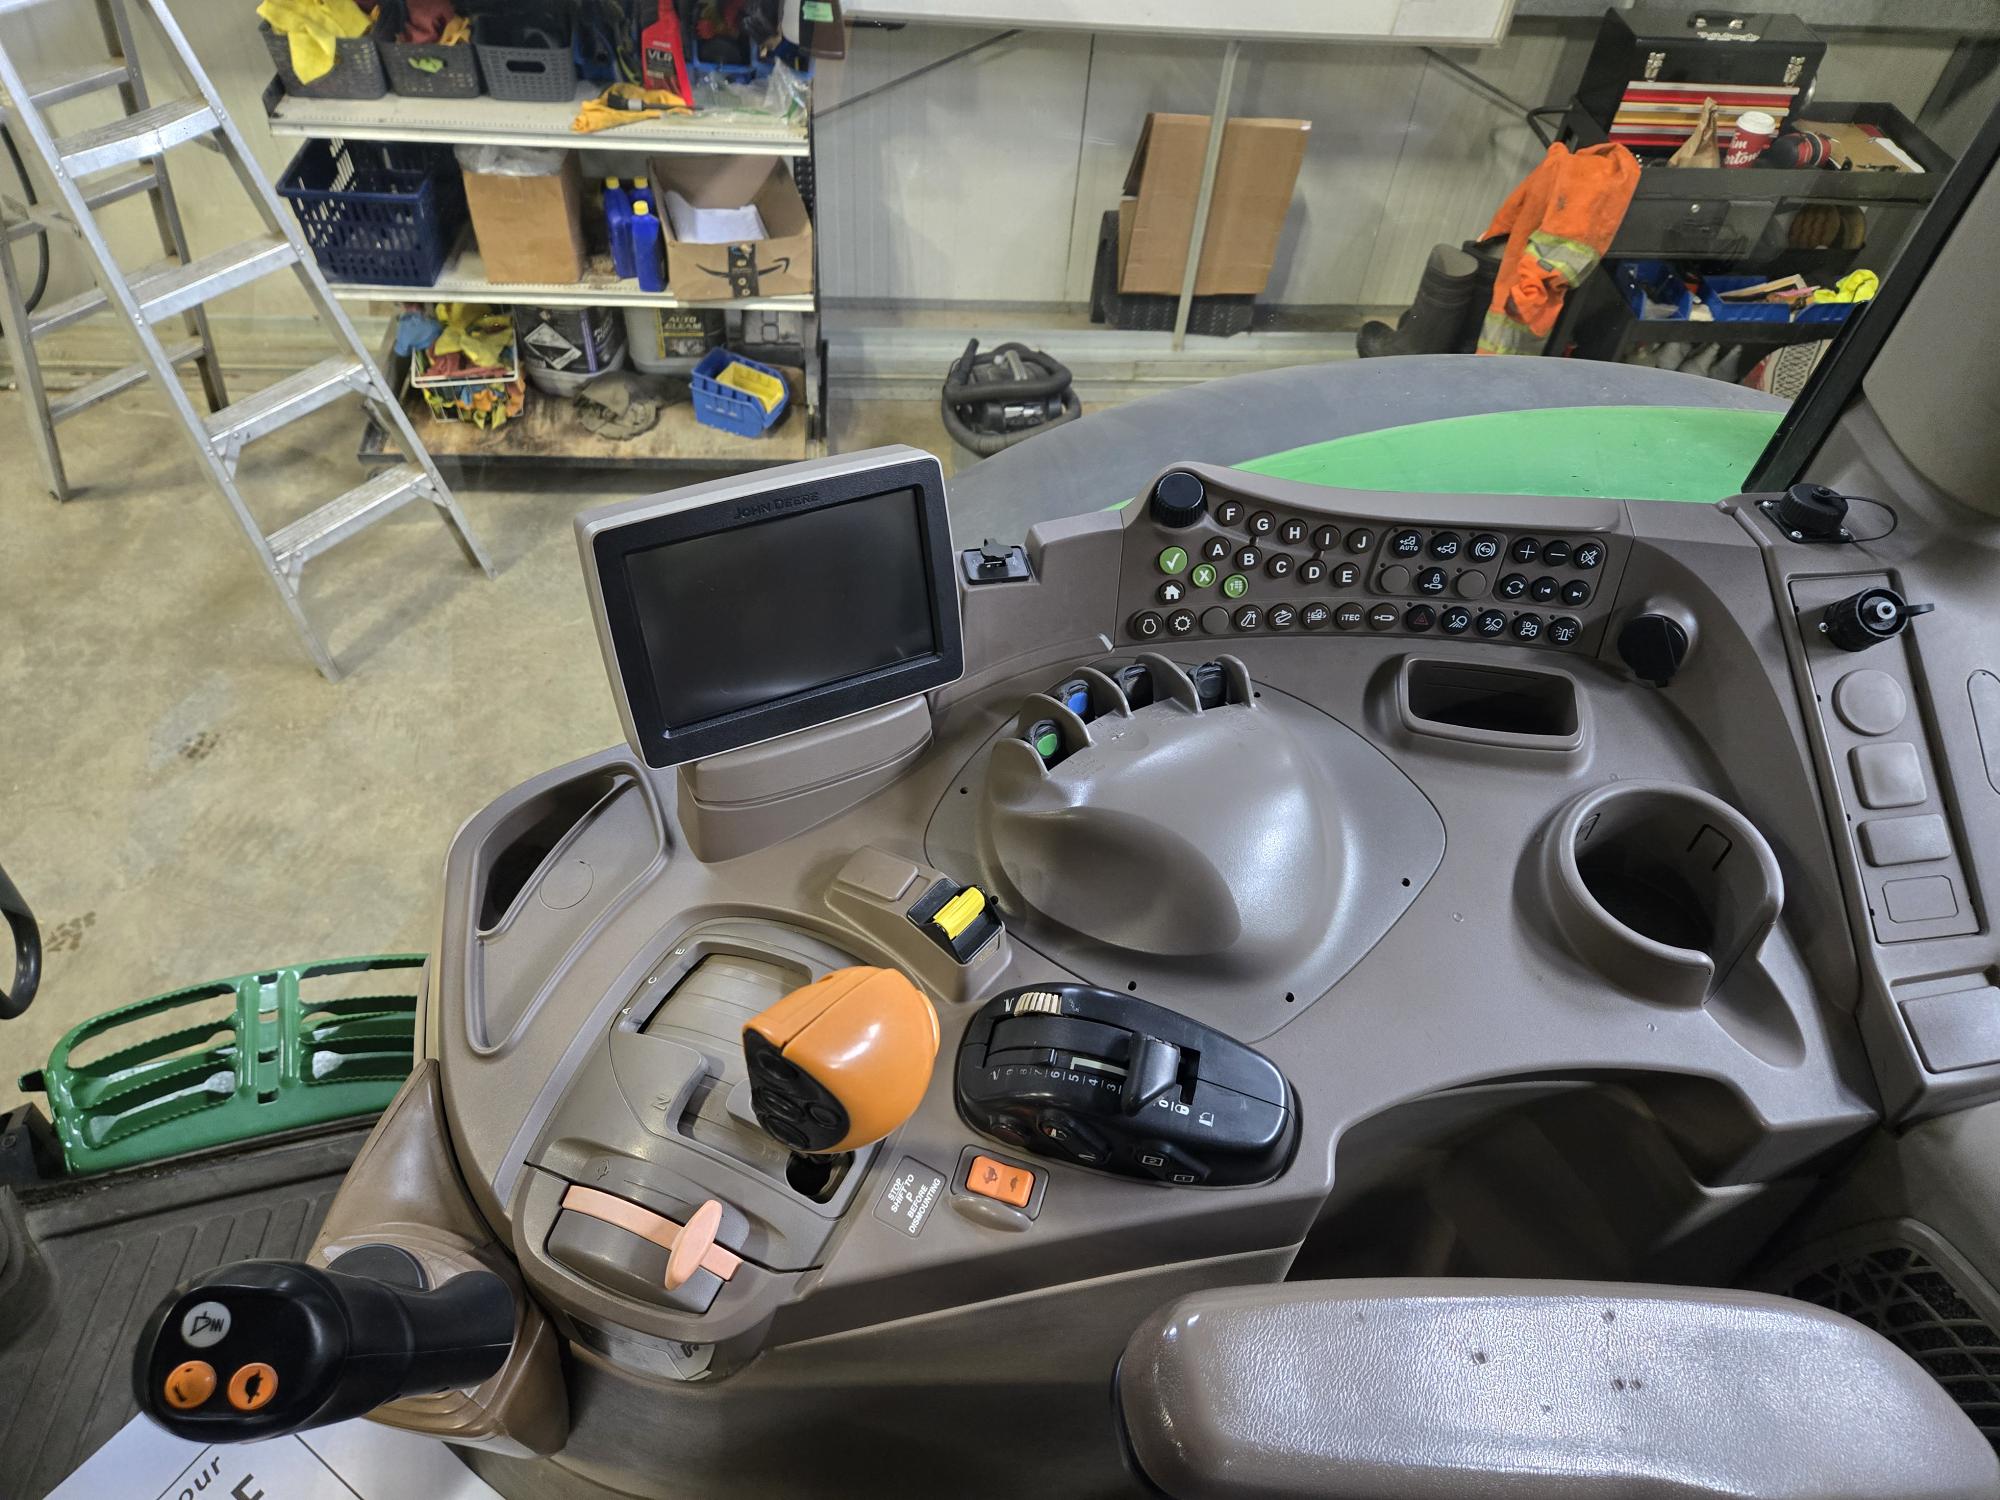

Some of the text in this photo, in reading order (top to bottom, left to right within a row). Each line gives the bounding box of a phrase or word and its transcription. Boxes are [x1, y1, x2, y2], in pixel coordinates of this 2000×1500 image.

[735, 492, 819, 520] JOHN DEERE
[1226, 508, 1236, 521] F
[1256, 518, 1269, 531] G
[1289, 527, 1300, 540] H
[1324, 533, 1330, 545] I
[1357, 536, 1366, 549] J
[1399, 544, 1419, 552] AUTO
[1212, 543, 1225, 556] A
[1243, 553, 1255, 566] B
[1276, 561, 1287, 573] C
[1308, 567, 1320, 579] D
[1342, 570, 1353, 583] E
[1341, 613, 1361, 622] iTEC
[622, 1006, 632, 1015] A
[1050, 1070, 1061, 1079] 6
[1068, 1073, 1080, 1082] 5
[1088, 1076, 1099, 1086] 4
[1106, 1082, 1117, 1092] 3
[887, 1177, 903, 1201] STOP
[891, 1174, 915, 1213] SHIFT TO
[905, 1191, 913, 1203] P
[907, 1184, 929, 1219] BEFORE
[908, 1177, 941, 1234] DISMOUNTING
